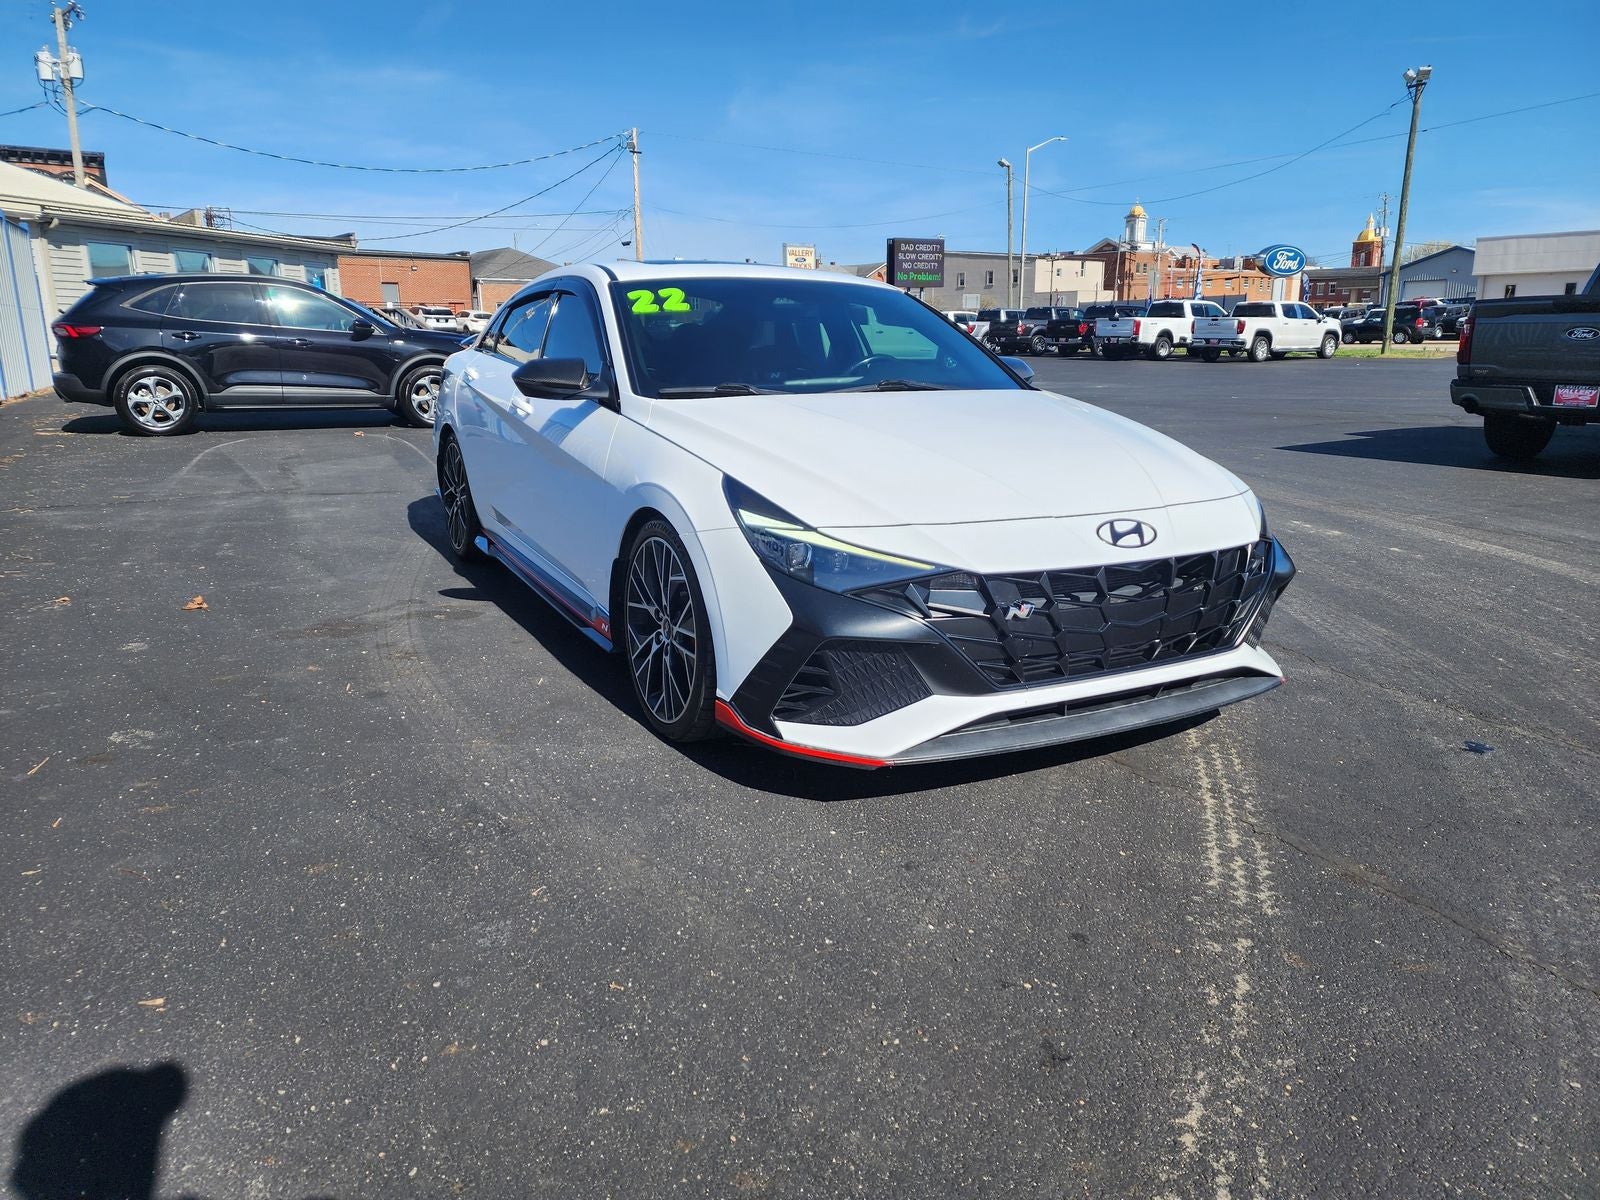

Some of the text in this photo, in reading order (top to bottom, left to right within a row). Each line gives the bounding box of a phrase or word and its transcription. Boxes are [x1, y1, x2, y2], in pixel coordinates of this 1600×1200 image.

[900, 243, 914, 251] BAD
[787, 248, 814, 257] VALLERY
[898, 252, 943, 261] SLOW CREDIT?
[1273, 250, 1300, 270] Ford
[913, 262, 938, 270] CREDIT?
[897, 271, 941, 281] No Problem!
[626, 287, 690, 314] 22
[1571, 328, 1595, 338] Ford
[1558, 388, 1598, 397] VALLERY
